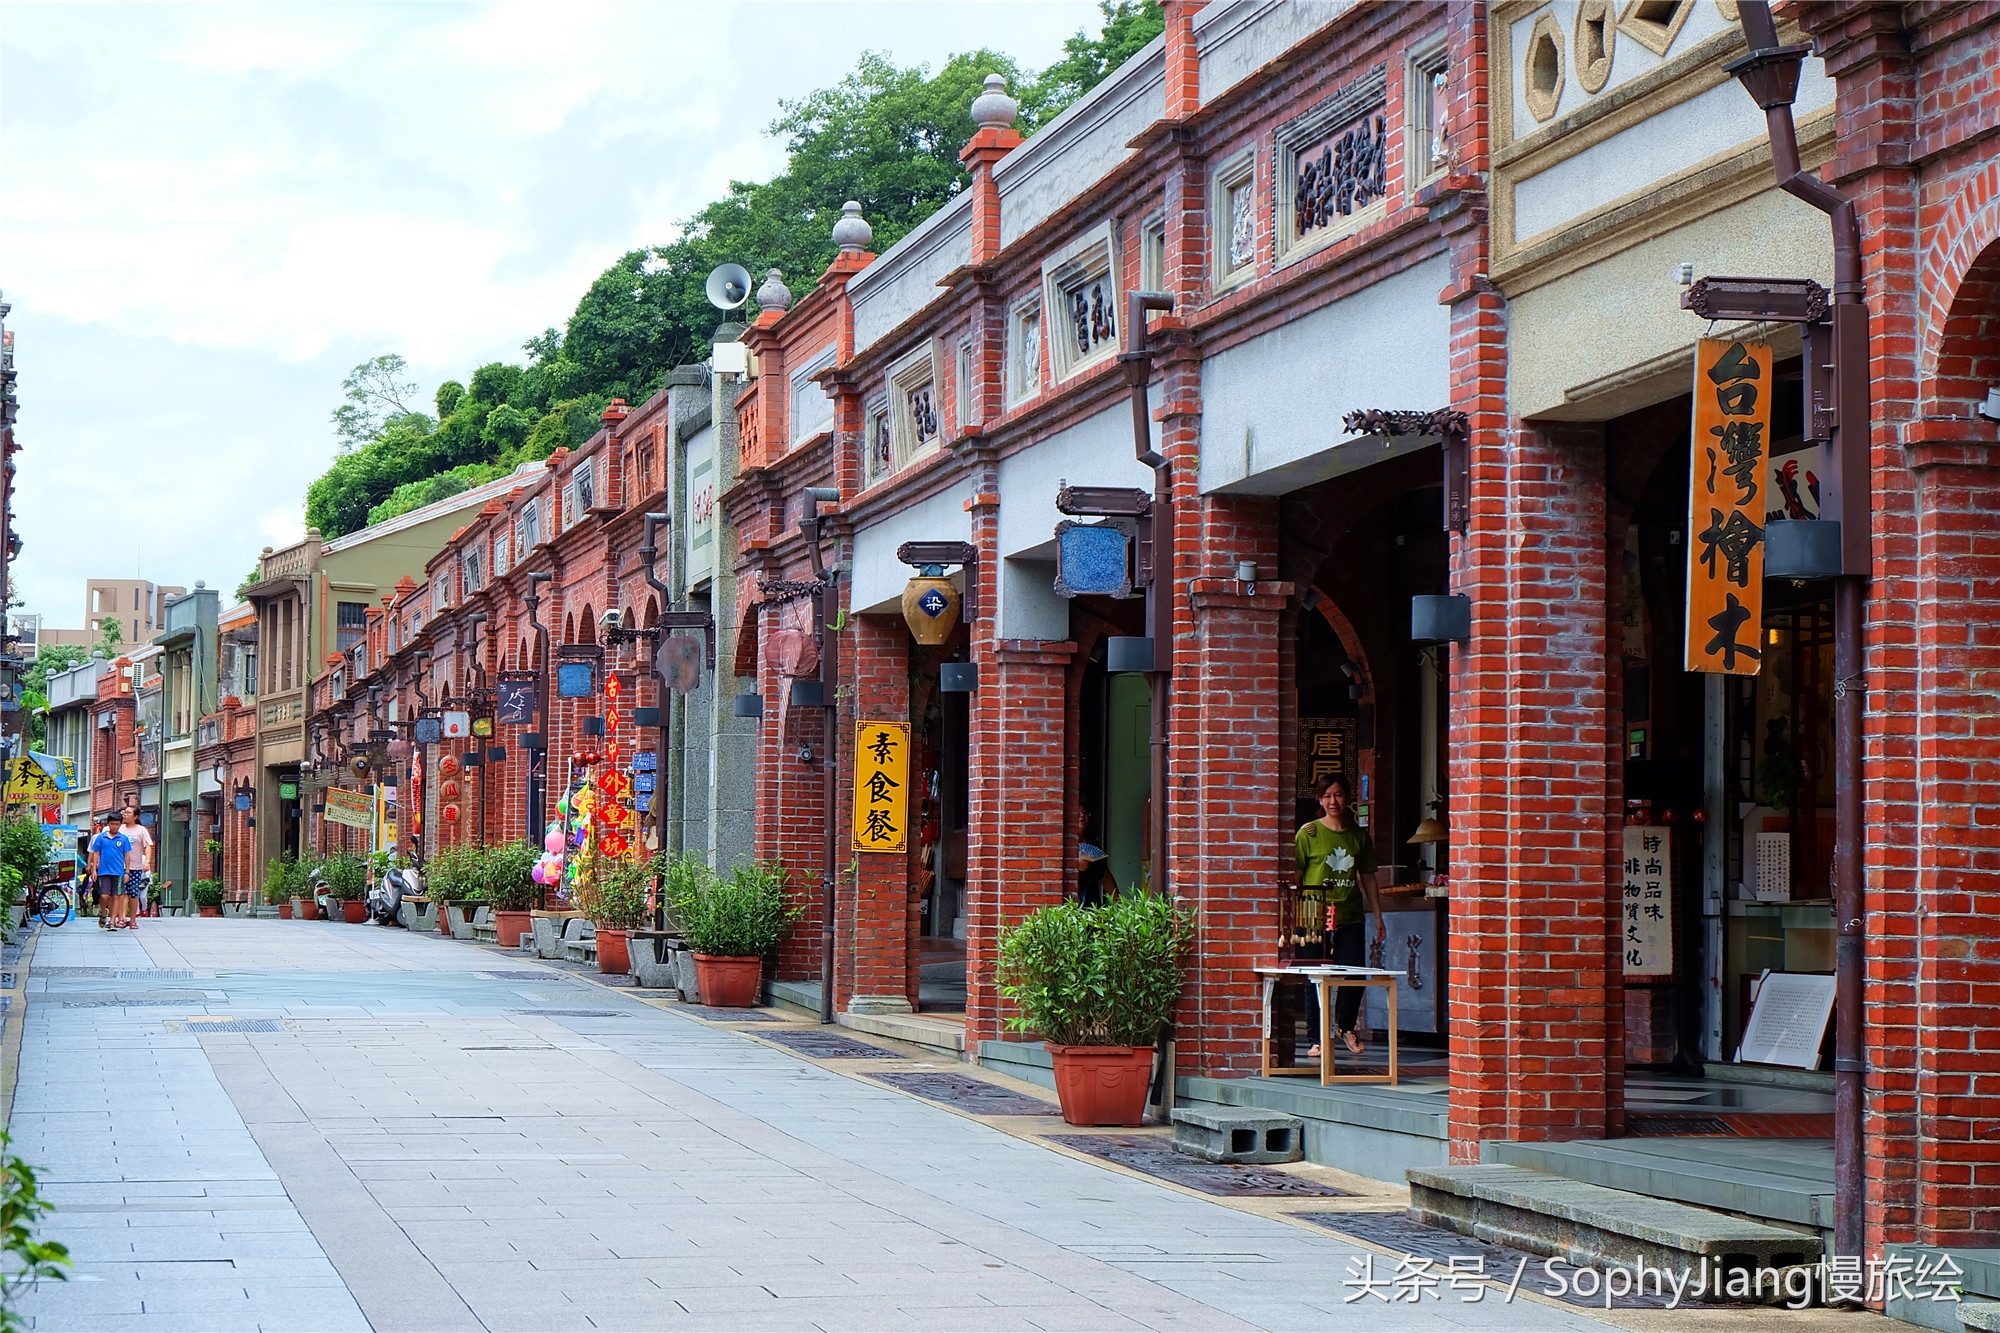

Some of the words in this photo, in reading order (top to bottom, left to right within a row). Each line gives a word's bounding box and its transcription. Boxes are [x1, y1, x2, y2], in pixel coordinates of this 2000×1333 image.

[1699, 341, 1765, 670] 台灣檜木
[926, 595, 943, 611] 染
[443, 758, 458, 821] 冬瓜蛋
[604, 678, 624, 853] 古今中外童玩
[860, 731, 900, 842] 素食餐
[1624, 857, 1643, 967] 非物質文化
[1644, 836, 1664, 922] 時尚品味
